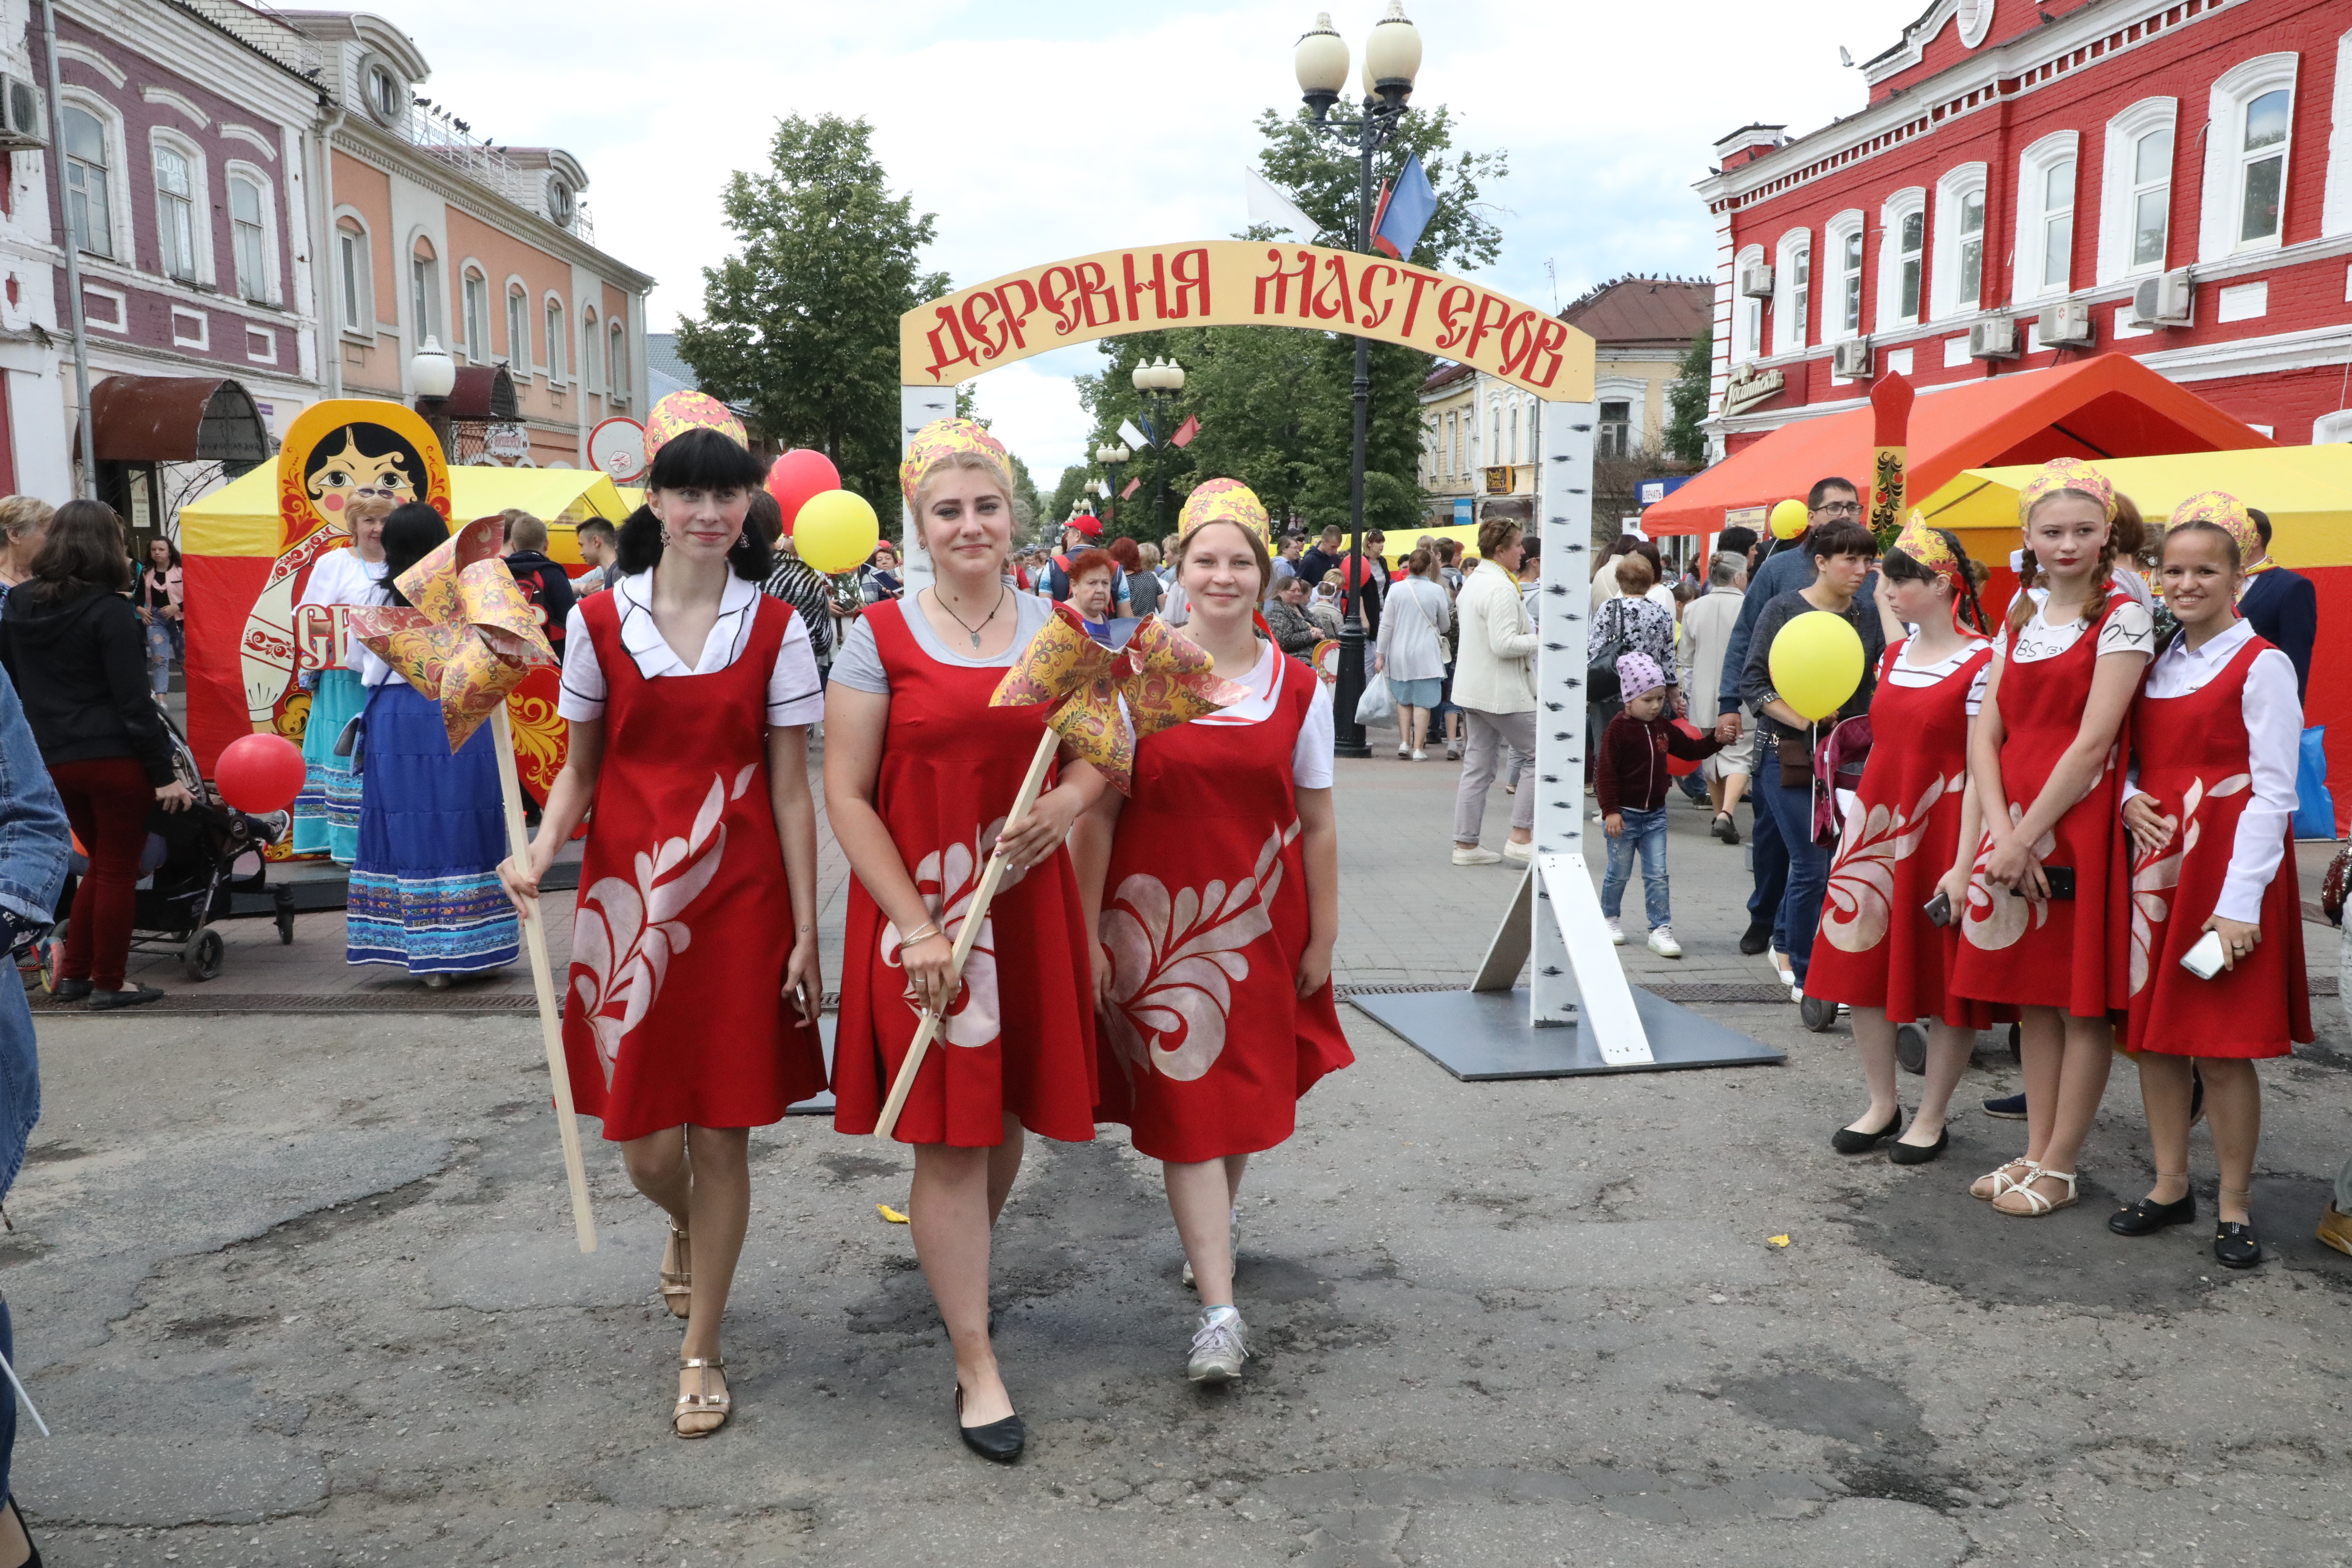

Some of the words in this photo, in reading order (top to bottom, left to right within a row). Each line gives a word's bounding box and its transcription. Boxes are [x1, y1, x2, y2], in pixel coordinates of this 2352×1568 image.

[925, 249, 1211, 383] ДЕРЕВНЯ
[1254, 249, 1567, 388] МАСТЕРОВ
[1719, 368, 1785, 417] Госаптека
